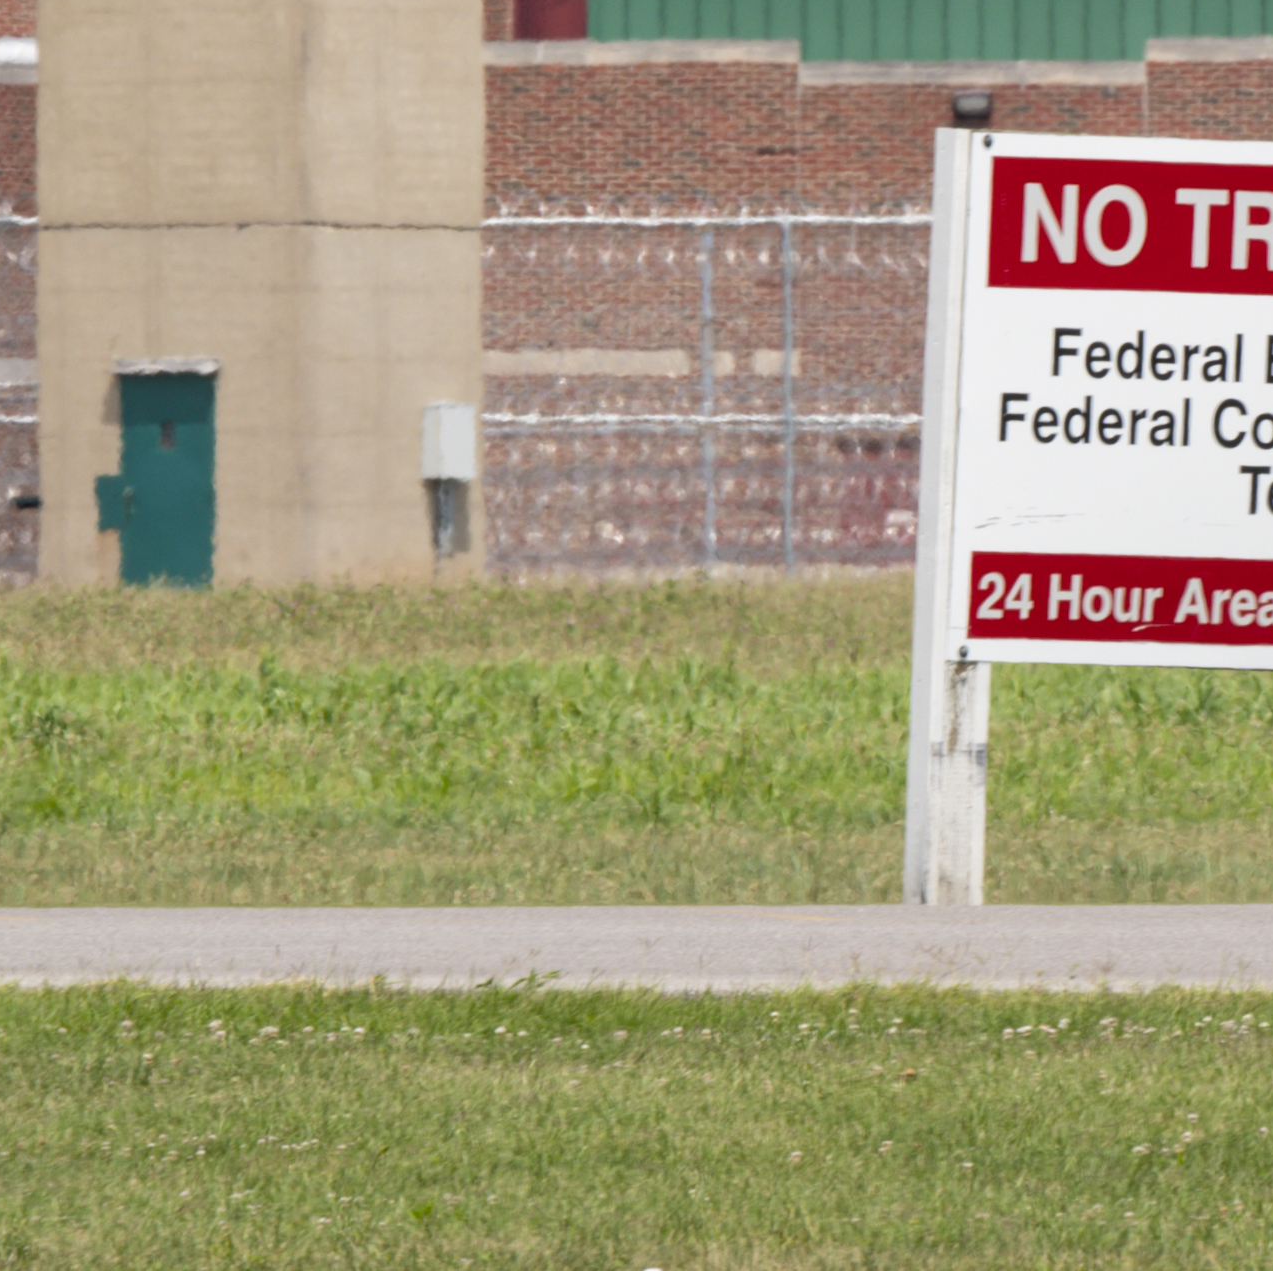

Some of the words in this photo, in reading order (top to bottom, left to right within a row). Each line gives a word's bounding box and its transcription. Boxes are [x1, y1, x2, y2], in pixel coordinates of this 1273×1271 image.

[1021, 183, 1147, 266] NO
[1053, 328, 1243, 383] Federal
[1000, 392, 1190, 447] Federal
[977, 571, 1034, 620] 24
[1047, 573, 1164, 623] Hour
